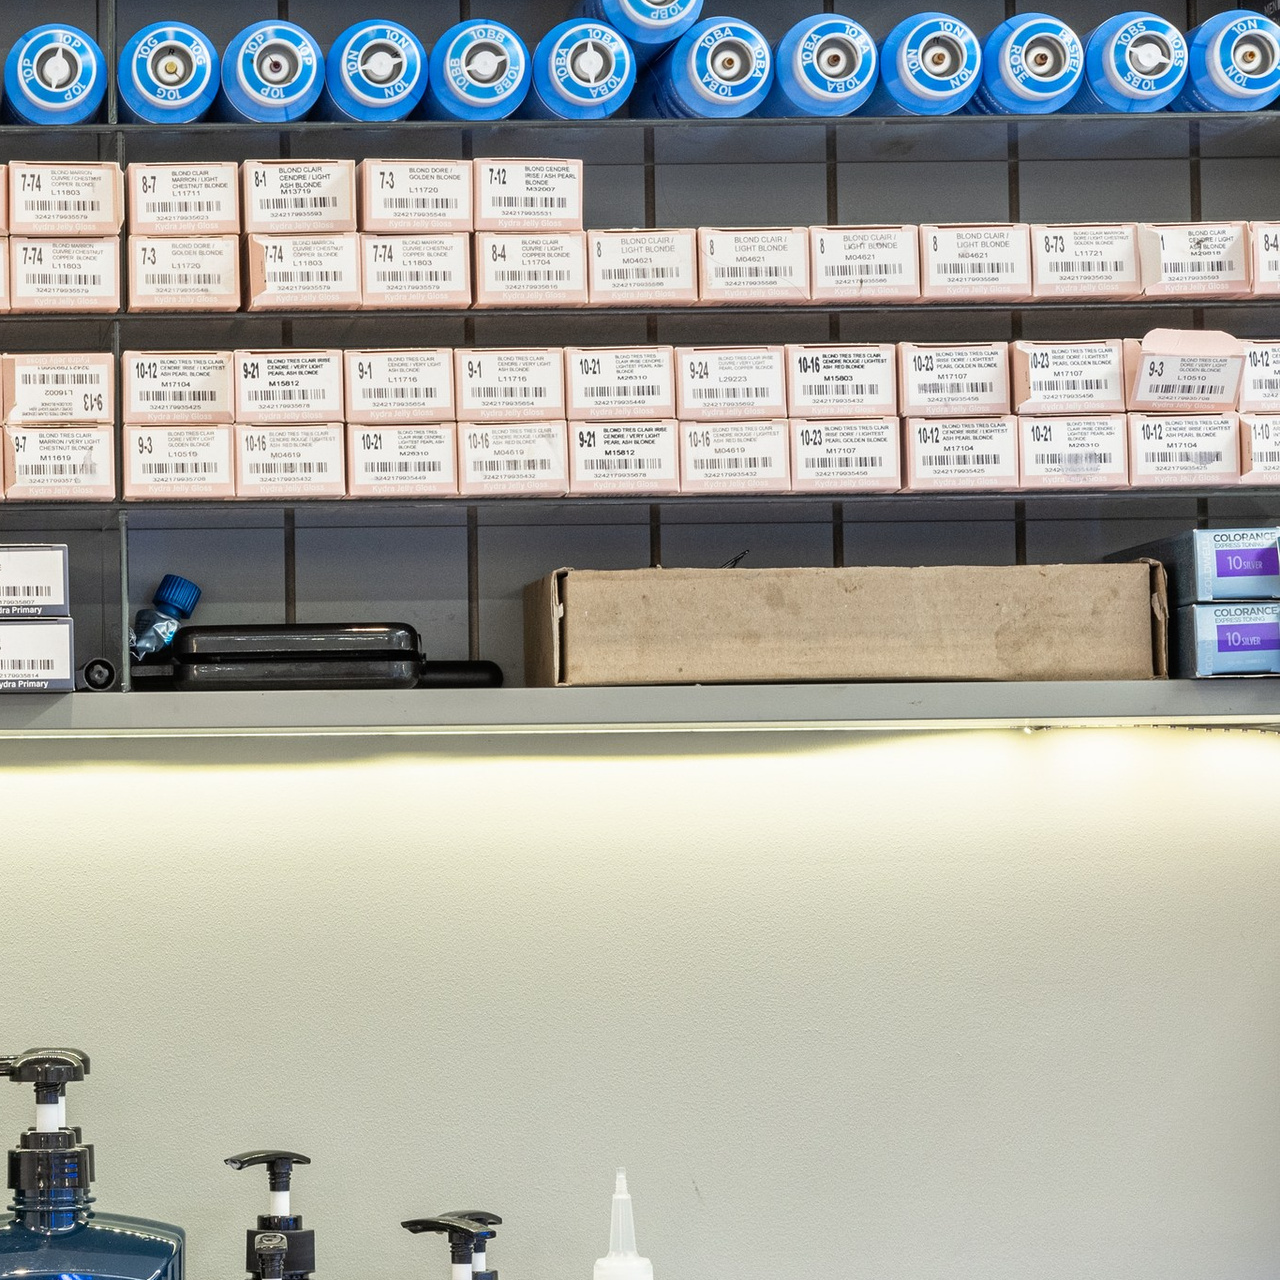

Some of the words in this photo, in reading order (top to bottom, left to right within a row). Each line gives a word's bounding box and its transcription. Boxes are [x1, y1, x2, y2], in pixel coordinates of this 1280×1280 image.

[1058, 28, 1080, 73] PASTEL
[1010, 44, 1030, 84] ROSE
[141, 176, 157, 193] 8-7
[489, 169, 507, 185] 7-12
[491, 244, 507, 261] 8-4
[579, 358, 602, 375] 10-21
[797, 356, 820, 373] 10-16
[1213, 532, 1276, 543] COLORANCE
[1227, 555, 1242, 570] 10
[1243, 561, 1263, 570] SILVER
